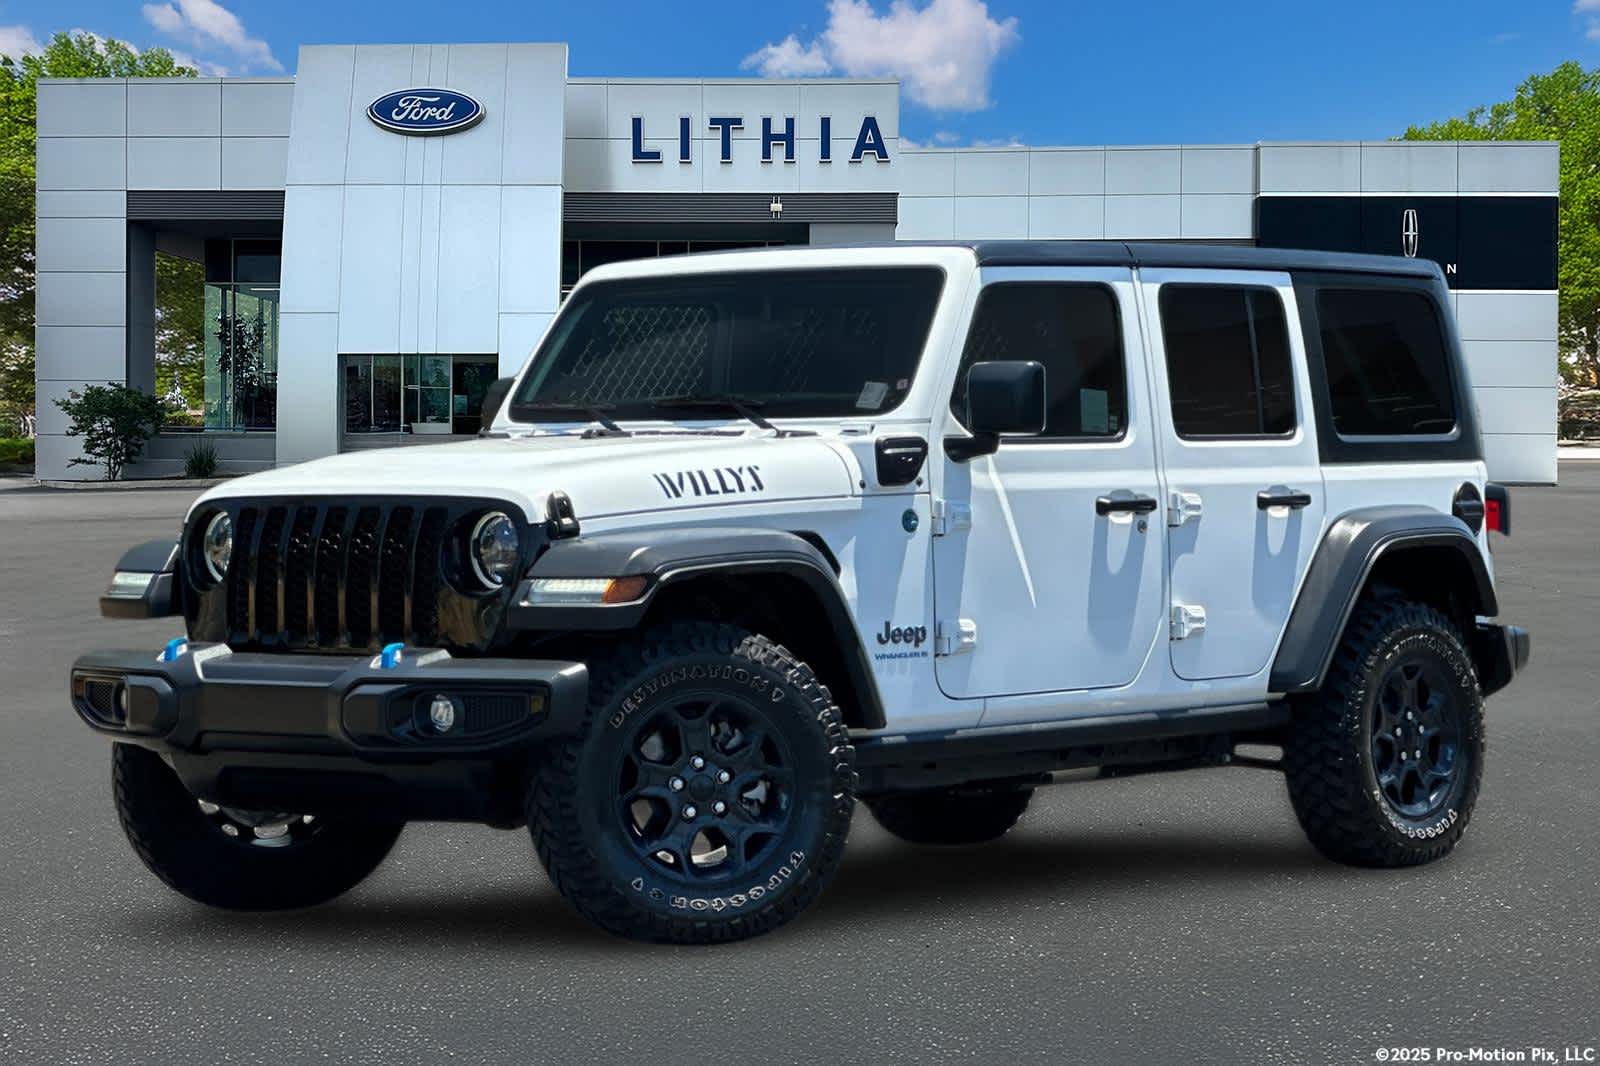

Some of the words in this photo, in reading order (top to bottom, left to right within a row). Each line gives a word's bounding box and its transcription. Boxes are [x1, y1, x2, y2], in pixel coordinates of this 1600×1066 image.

[391, 95, 456, 121] Ford
[631, 116, 890, 163] LITHIA
[652, 465, 764, 499] WILLYS
[876, 620, 928, 649] Jeep
[608, 663, 770, 729] DESTINATION
